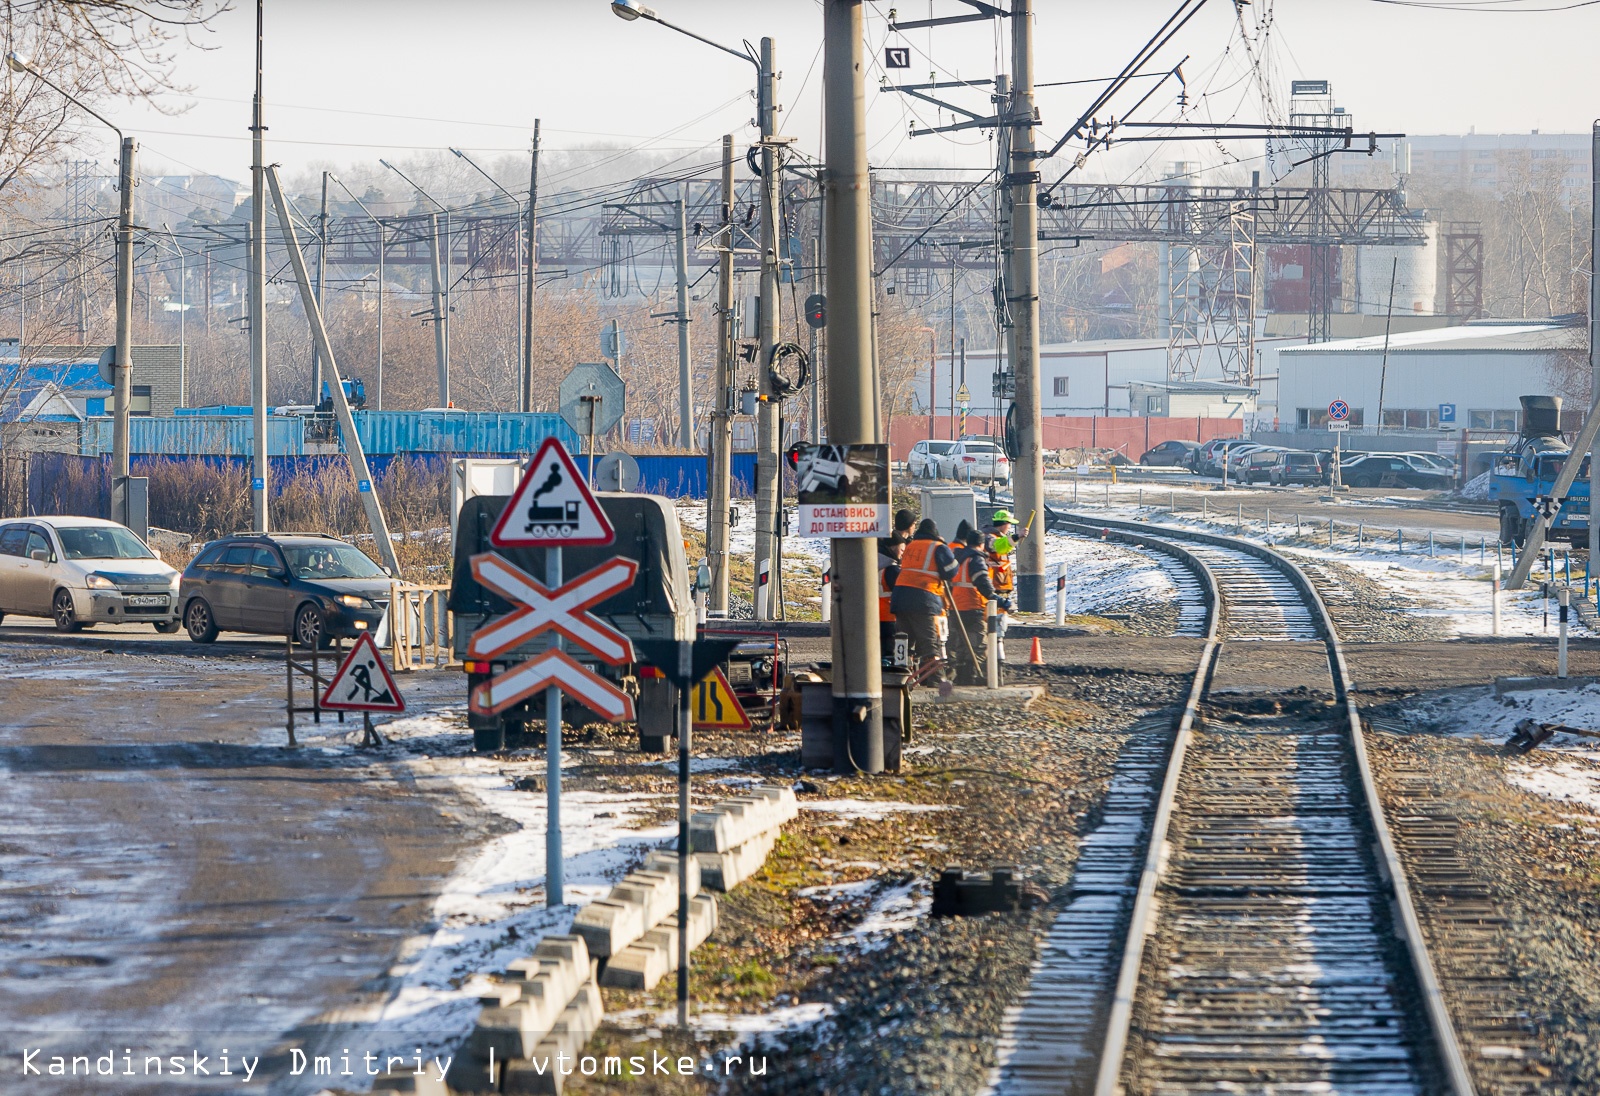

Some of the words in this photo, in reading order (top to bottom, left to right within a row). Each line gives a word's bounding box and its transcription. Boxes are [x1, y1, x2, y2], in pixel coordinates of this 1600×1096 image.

[1442, 405, 1452, 420] P
[813, 507, 875, 518] ОСТАНОВИСЬ
[810, 521, 824, 534] ДО
[826, 521, 879, 534] ПЕРЕЕЗДА!
[897, 644, 905, 661] 9
